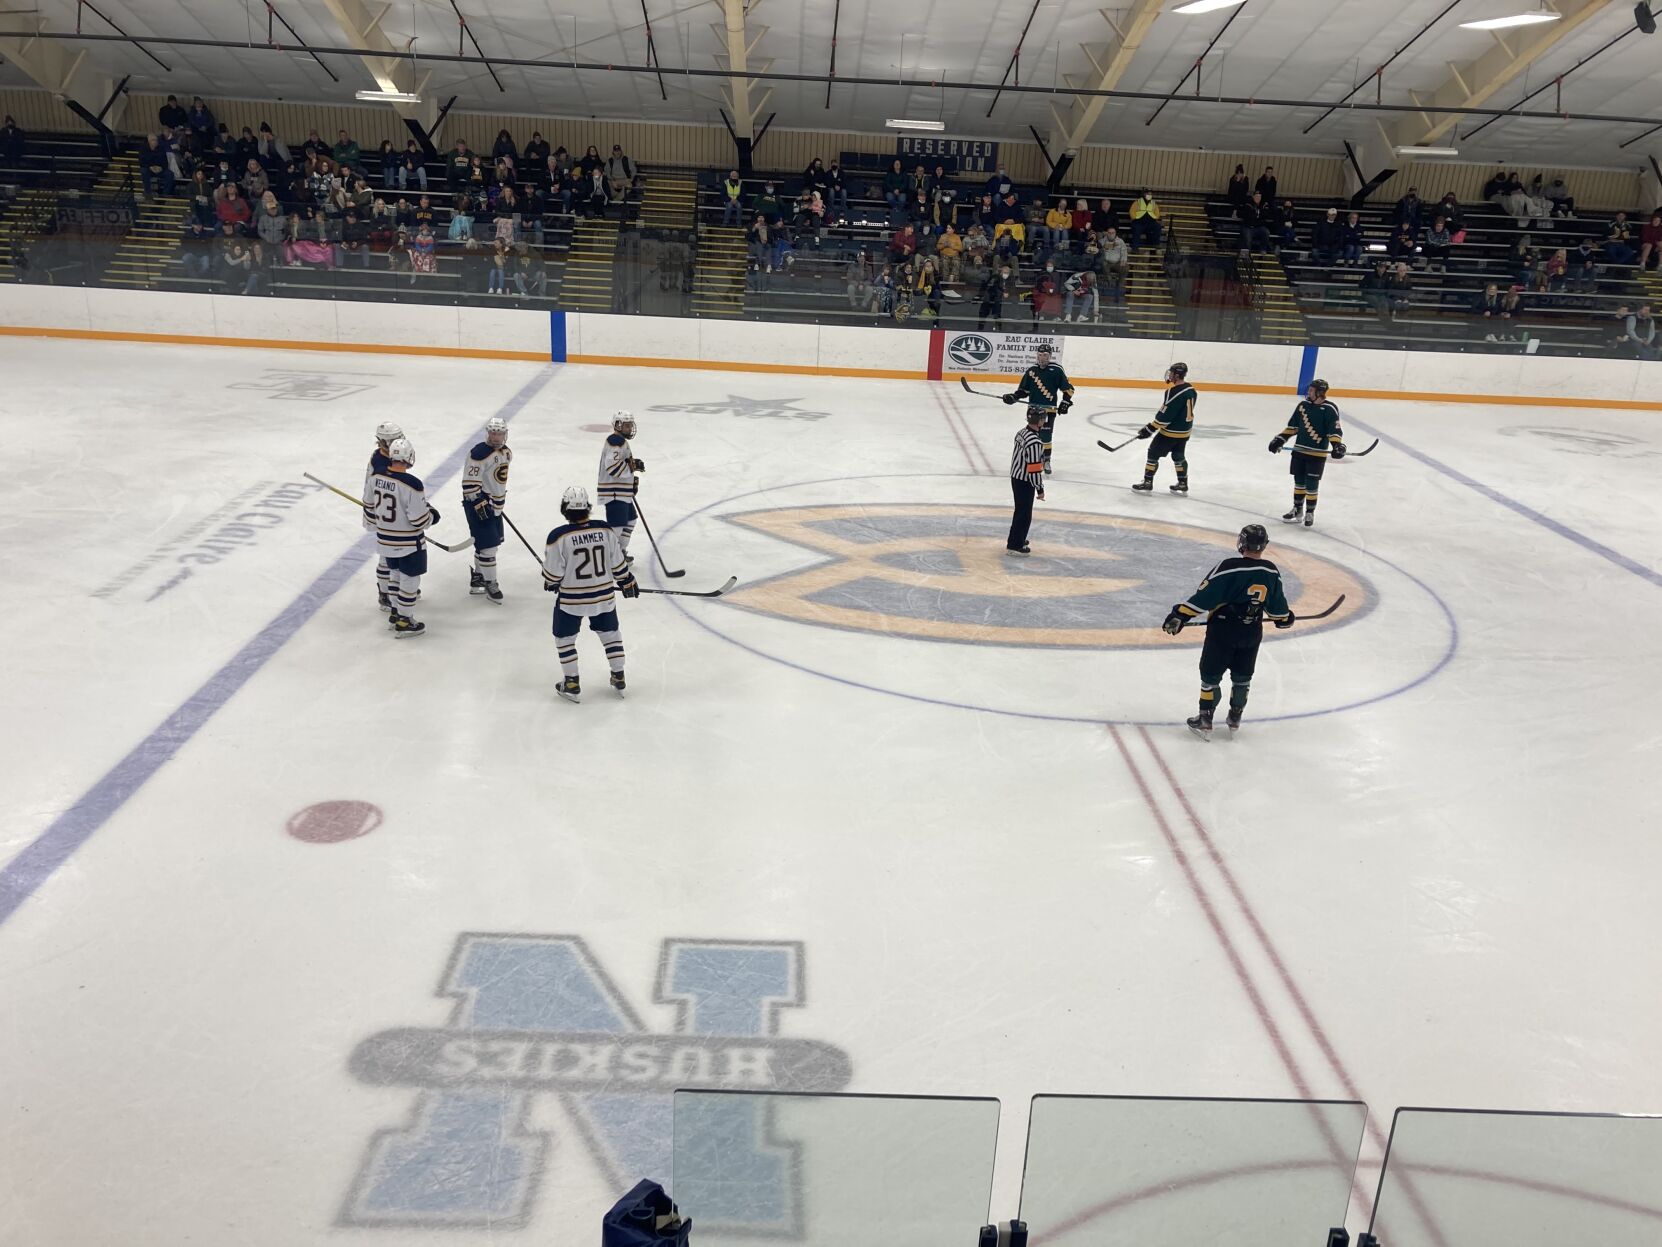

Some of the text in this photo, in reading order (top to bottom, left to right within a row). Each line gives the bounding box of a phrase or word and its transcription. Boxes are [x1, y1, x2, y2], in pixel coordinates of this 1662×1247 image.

[902, 138, 993, 157] RESERVED
[1005, 335, 1021, 343] EAU
[996, 344, 1027, 352] FAMILY
[571, 531, 605, 547] HAMMER
[574, 545, 606, 580] 20
[437, 1040, 776, 1084] HUSKIES
